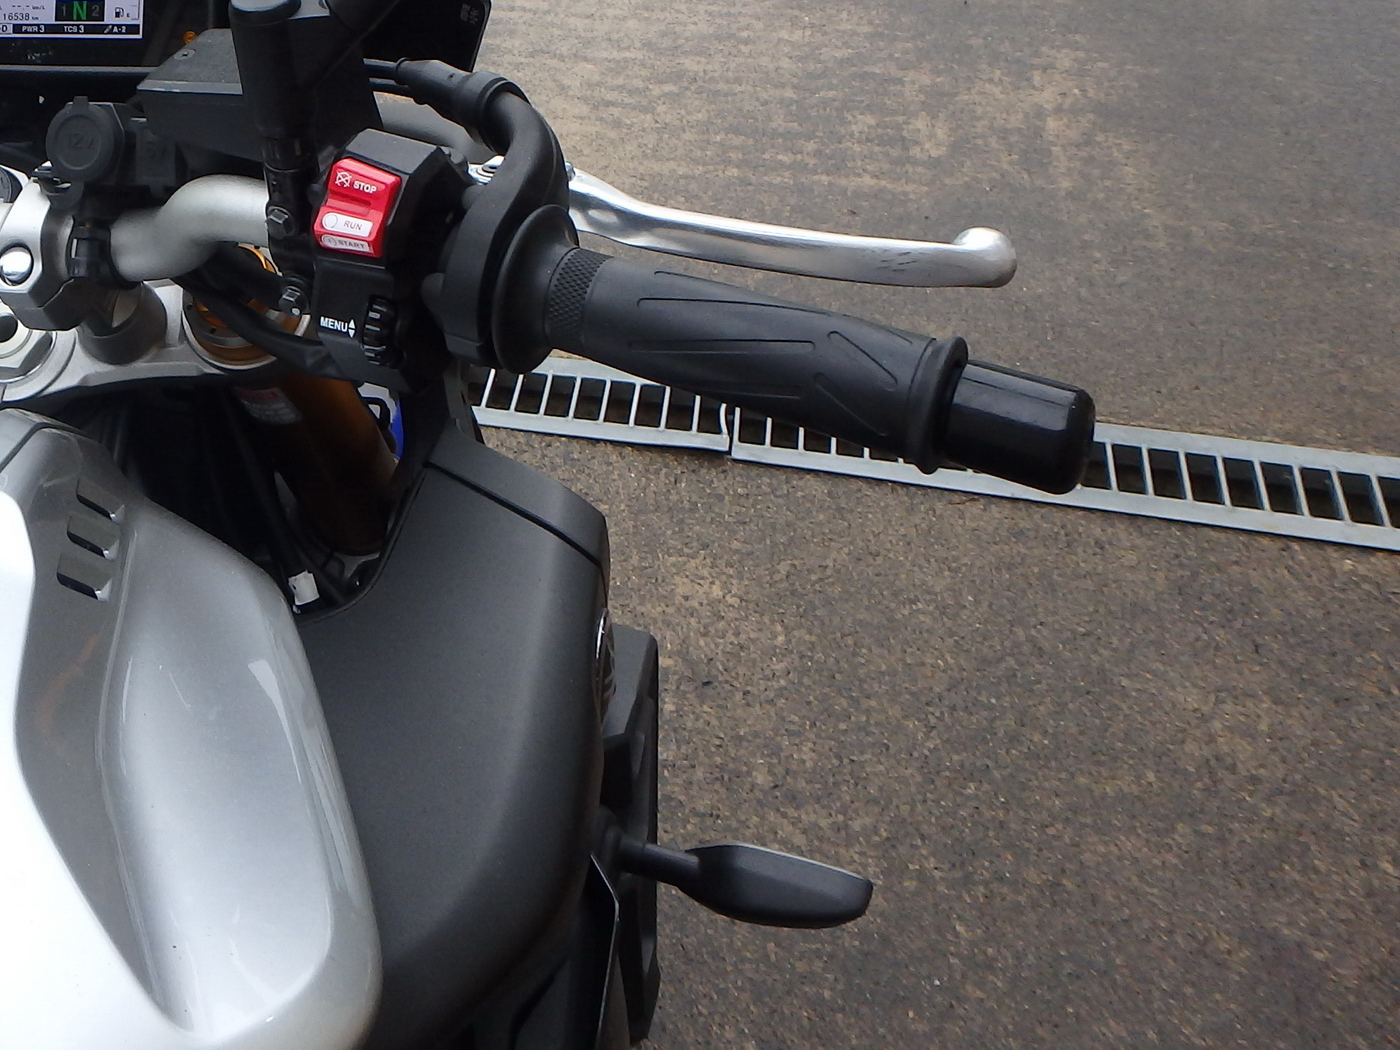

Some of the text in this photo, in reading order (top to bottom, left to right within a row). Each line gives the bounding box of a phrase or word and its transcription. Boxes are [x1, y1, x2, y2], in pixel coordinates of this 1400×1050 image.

[3, 12, 30, 21] 16538
[72, 0, 88, 21] N
[91, 4, 100, 17] 2
[63, 25, 85, 33] TCS 3
[353, 179, 377, 194] STOP
[343, 220, 362, 231] RUN
[337, 238, 366, 250] START
[320, 316, 348, 333] MENU
